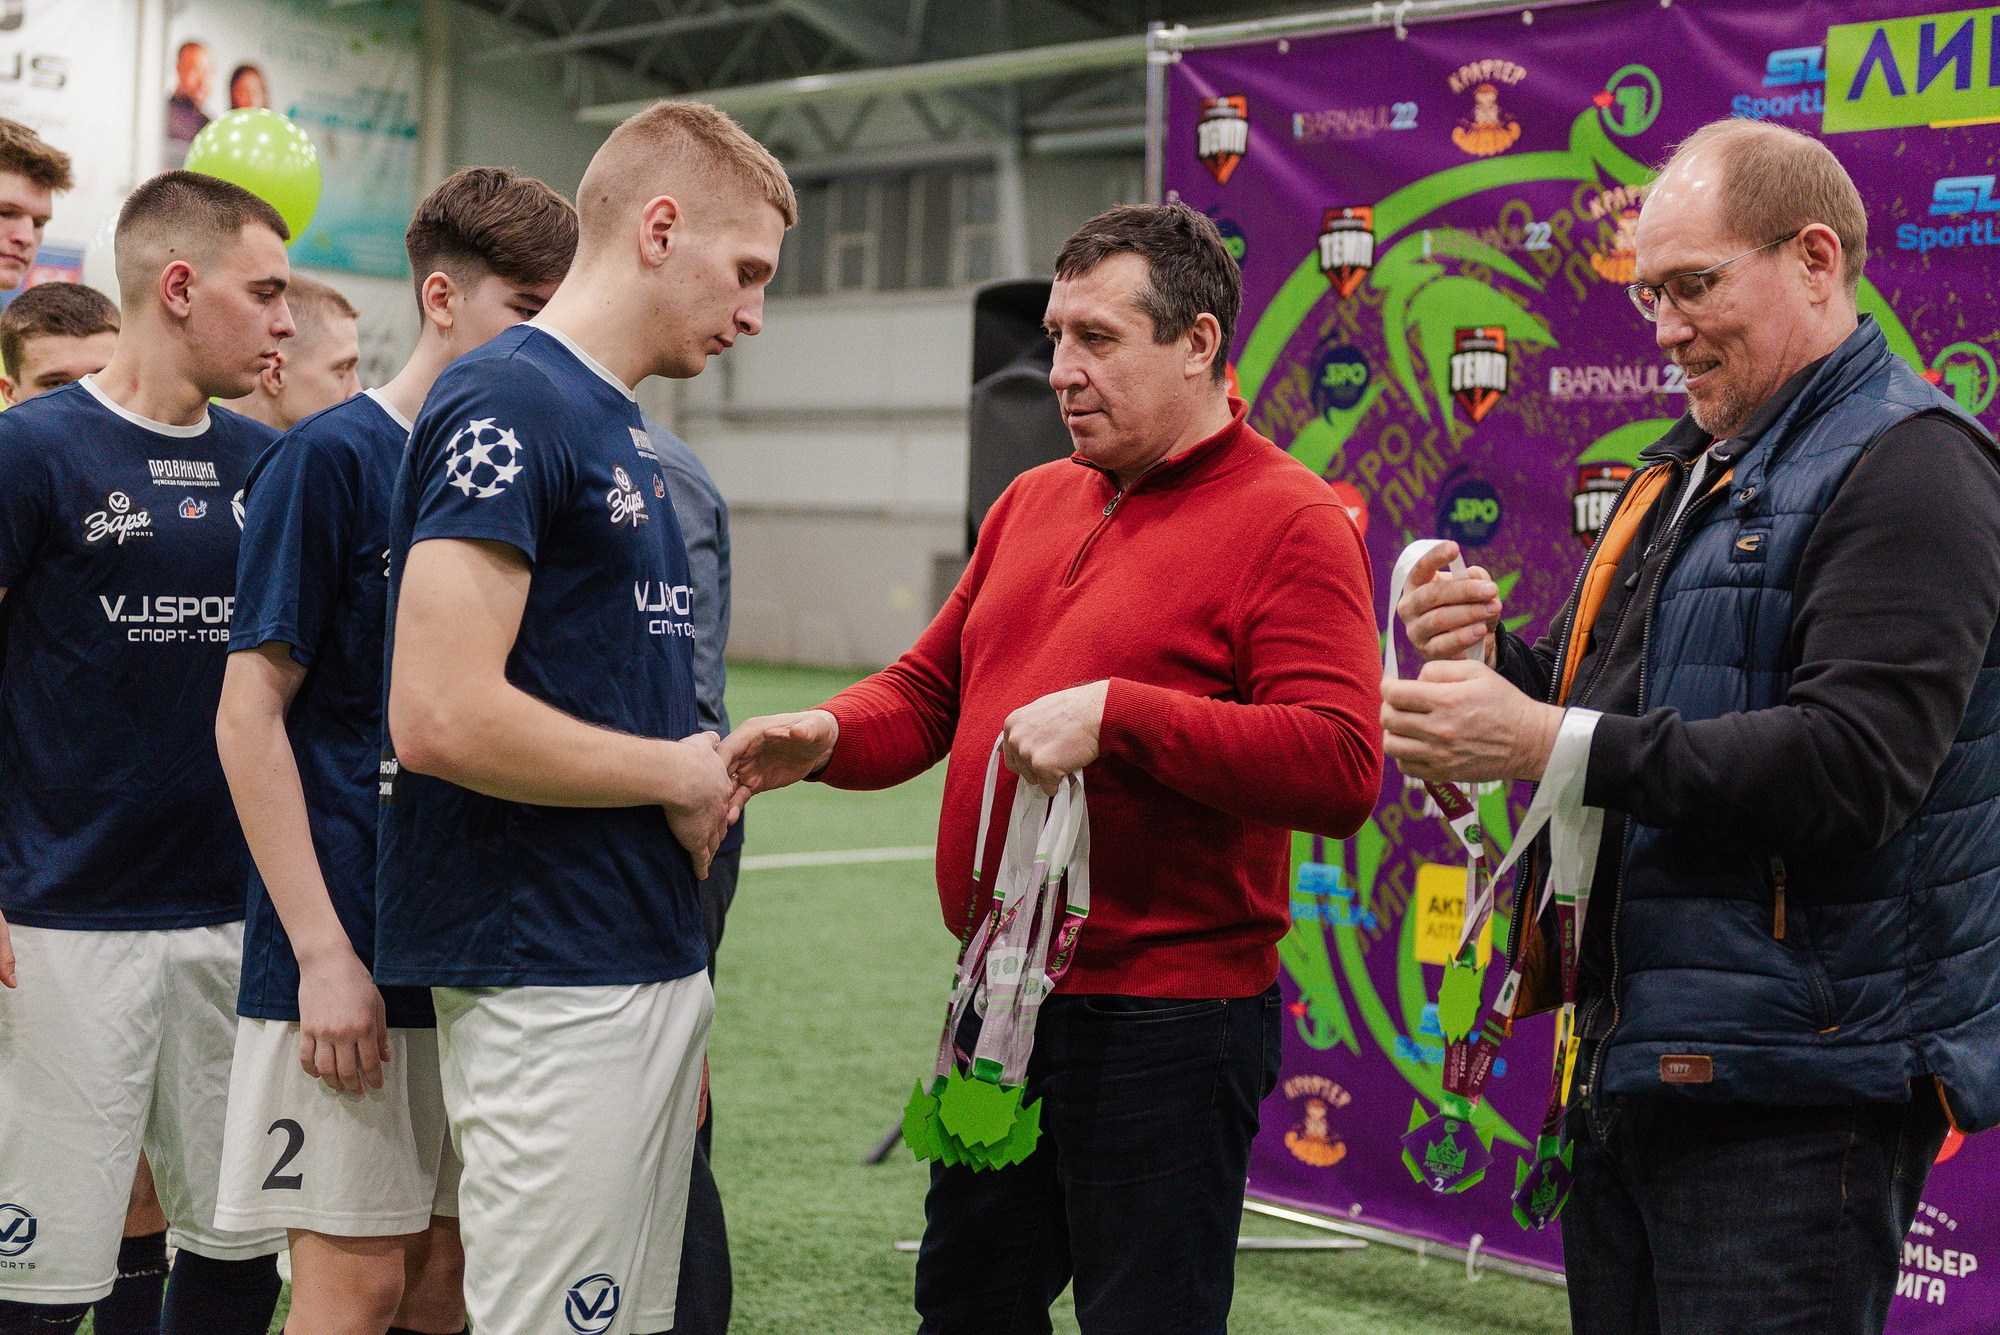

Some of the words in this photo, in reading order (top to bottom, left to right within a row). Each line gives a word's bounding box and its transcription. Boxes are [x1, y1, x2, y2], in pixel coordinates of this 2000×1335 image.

[1451, 352, 1507, 391] ТЕМП
[148, 459, 218, 481] ПРОВИНЦИЯ
[85, 511, 151, 545] Заря
[262, 1119, 305, 1191] 2
[1432, 1177, 1445, 1192] 2
[1899, 1241, 1978, 1279] МЬЕР
